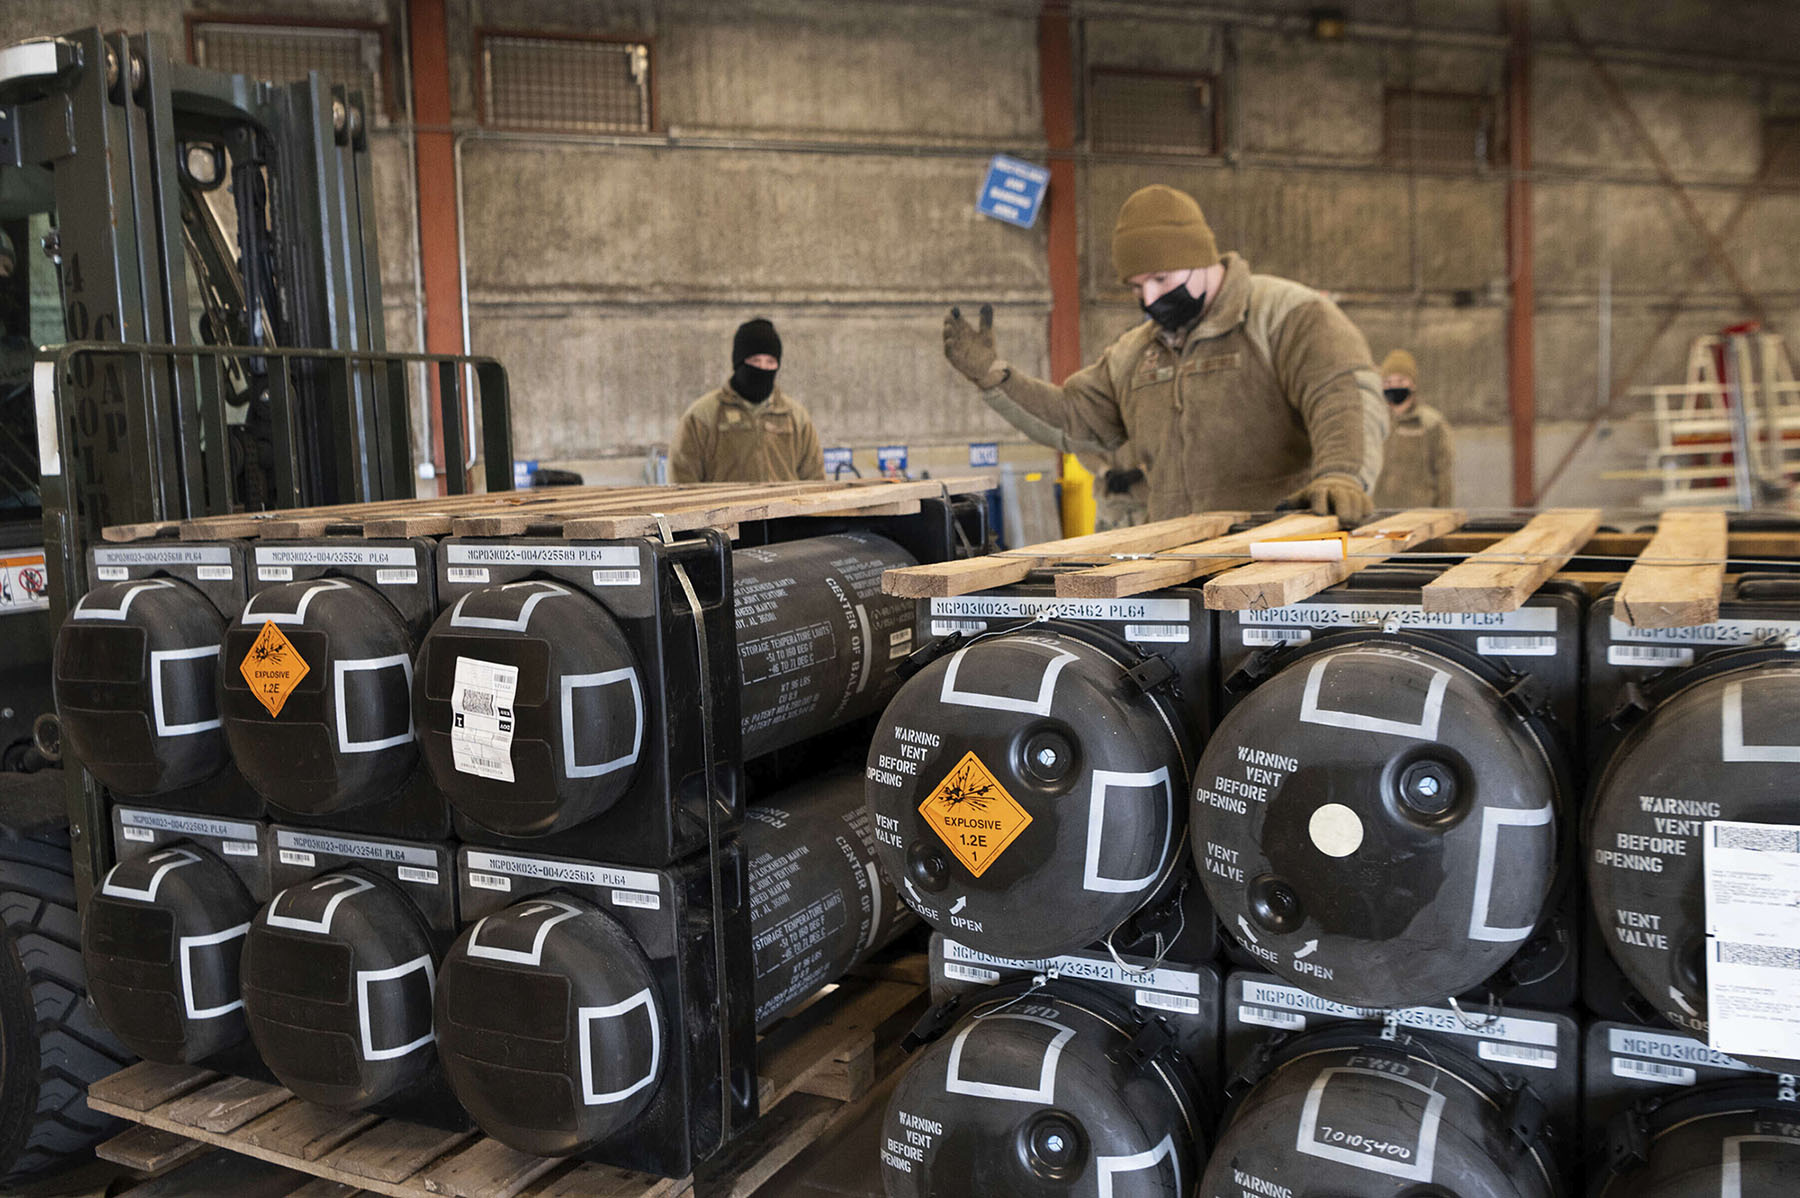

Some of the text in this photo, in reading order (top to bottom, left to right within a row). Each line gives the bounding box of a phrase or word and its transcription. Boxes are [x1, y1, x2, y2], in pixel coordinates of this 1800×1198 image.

[369, 552, 389, 563] PL64
[579, 551, 602, 561] PL64
[825, 577, 858, 630] CENTER
[1109, 605, 1145, 618] PL64
[1461, 611, 1505, 625] PL64
[741, 641, 770, 657] STORAGE
[770, 630, 812, 650] TEMPERATURE
[851, 635, 861, 655] OF
[776, 650, 785, 660] TO
[781, 660, 789, 670] TO
[255, 671, 290, 679] EXPLOSIVE
[263, 683, 280, 693] 1.2E
[270, 696, 275, 705] 1
[894, 726, 940, 747] WARNING
[901, 743, 928, 761] VENT
[1238, 745, 1299, 773] WARNING
[879, 754, 917, 776] BEFORE
[867, 766, 902, 788] OPENING
[1246, 766, 1282, 787] VENT
[1215, 776, 1268, 803] BEFORE
[1196, 788, 1247, 815] OPENING
[1639, 795, 1721, 818] WARNING
[875, 813, 899, 833] VENT
[944, 816, 1002, 830] EXPLOSIVE
[1654, 817, 1702, 837] VENT
[875, 827, 903, 849] VALVE
[960, 833, 988, 848] 1.2E
[1616, 832, 1687, 856] BEFORE
[385, 849, 405, 860] PL64
[835, 836, 868, 890] CENTER
[971, 851, 977, 862] 1
[1207, 841, 1239, 864] VENT
[1595, 849, 1664, 873] OPENING
[602, 873, 626, 886] PL64
[1205, 857, 1244, 883] VALVE
[905, 897, 940, 921] CLOSE
[1616, 908, 1661, 930] VENT
[755, 927, 784, 951] STORAGE
[783, 903, 824, 933] TEMPERATURE
[950, 915, 984, 933] OPEN
[1615, 927, 1669, 950] VALVE
[1236, 935, 1279, 964] CLOSE
[1293, 959, 1333, 980] OPEN
[1667, 1011, 1709, 1032] CLOS
[1347, 1056, 1411, 1076] FWD
[899, 1110, 942, 1136] WARNING
[906, 1129, 932, 1149] VENT
[880, 1147, 912, 1173] PENING
[887, 1138, 924, 1162] BEFORE
[1234, 1168, 1293, 1198] WARNING
